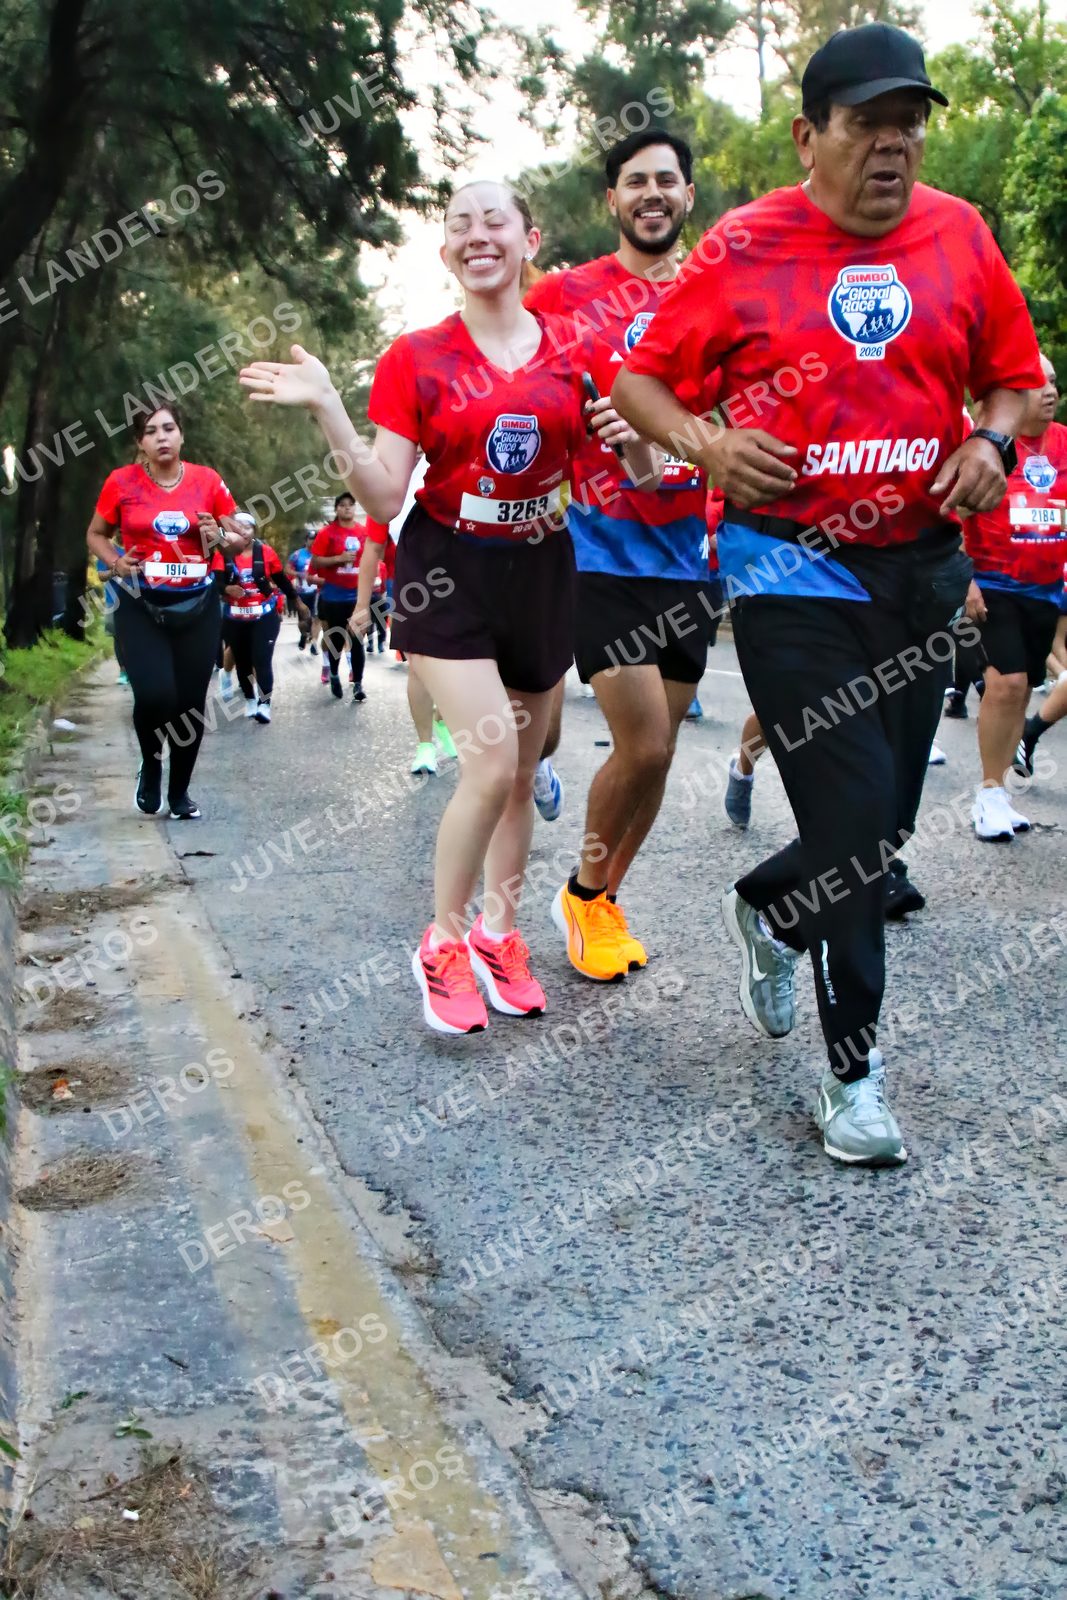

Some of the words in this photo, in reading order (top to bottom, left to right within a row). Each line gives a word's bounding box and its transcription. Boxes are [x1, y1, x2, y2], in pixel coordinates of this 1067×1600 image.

[846, 273, 889, 283] BIMBO
[848, 286, 891, 300] Global
[841, 299, 876, 313] Race
[859, 346, 883, 357] 2026
[501, 420, 532, 429] BIMBO
[802, 438, 939, 476] SANTIAGO
[497, 496, 549, 522] 3263
[1031, 509, 1055, 522] 2184
[166, 564, 187, 576] 1914
